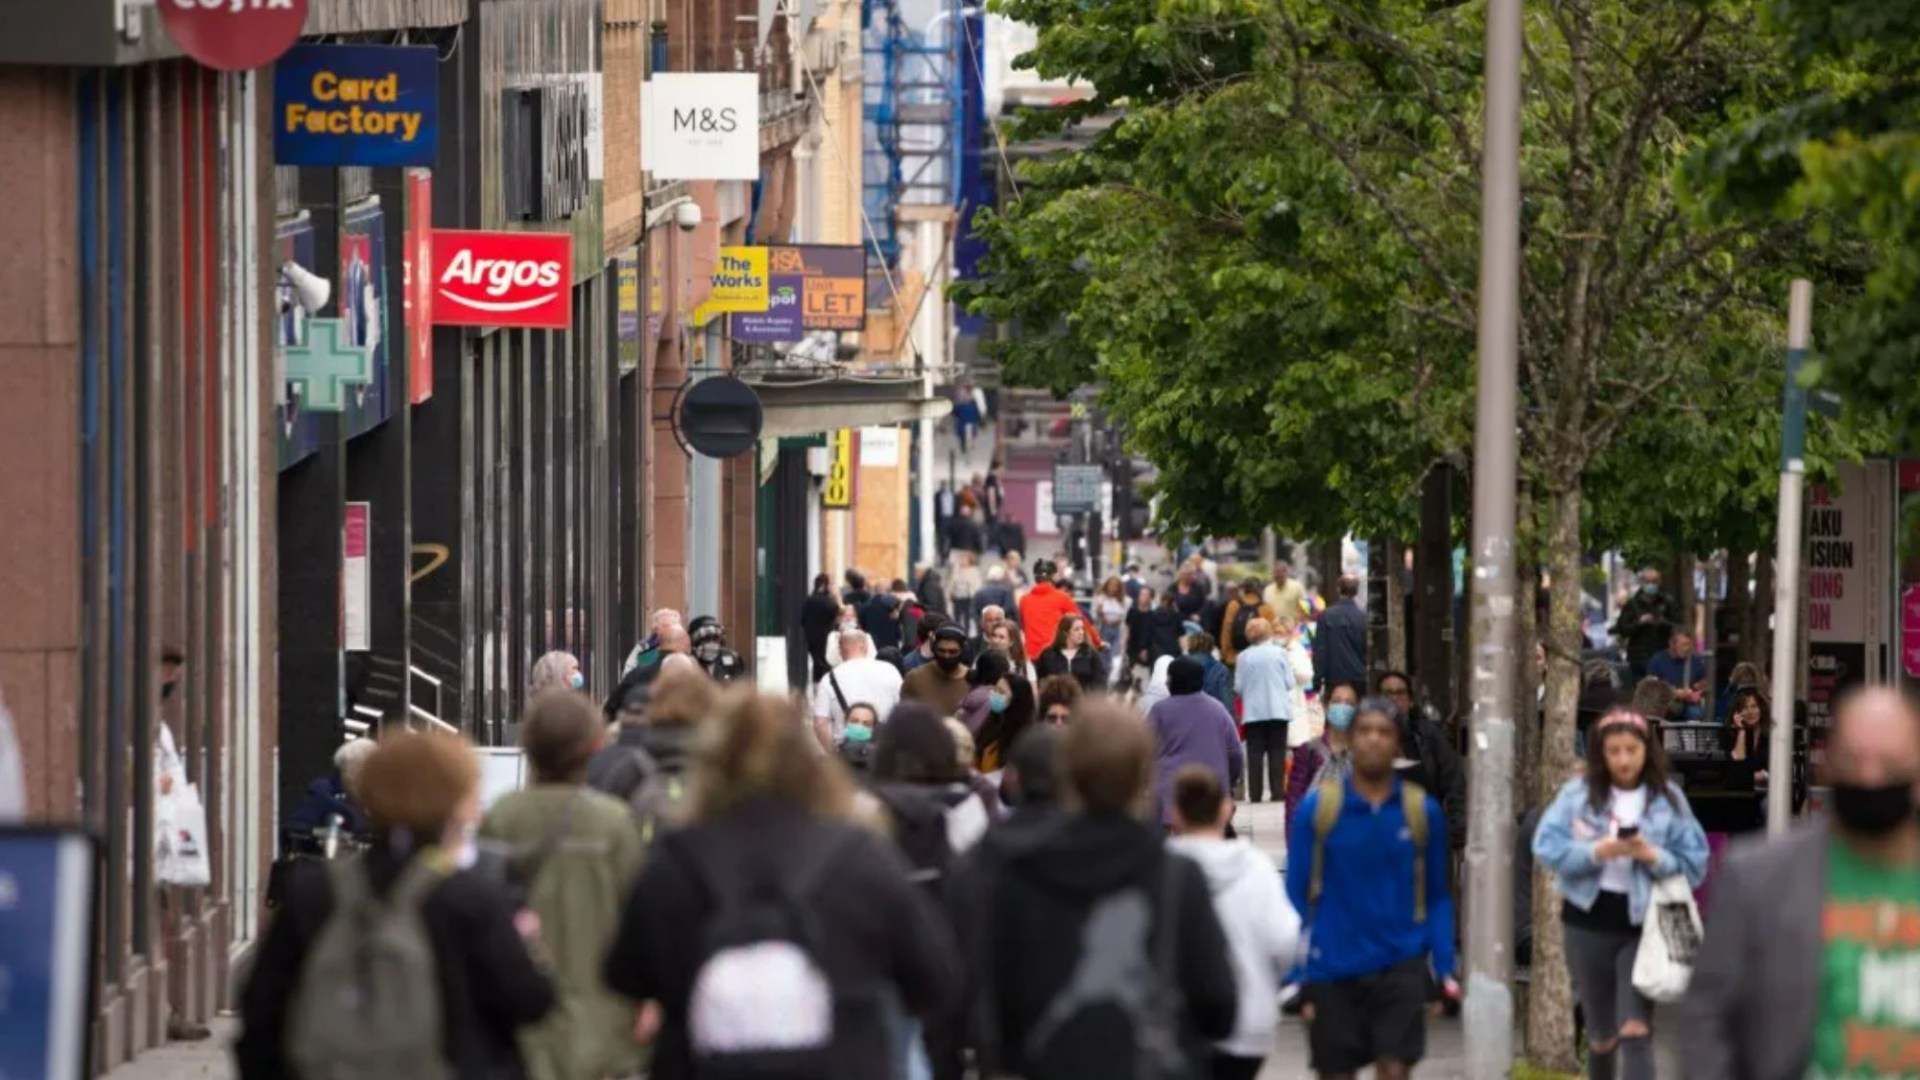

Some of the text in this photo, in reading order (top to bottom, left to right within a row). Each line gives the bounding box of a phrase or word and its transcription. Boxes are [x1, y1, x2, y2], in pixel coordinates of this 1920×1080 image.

[311, 70, 398, 102] Card
[285, 103, 422, 142] Factory
[673, 106, 738, 132] M&S
[440, 249, 562, 296] Argos
[721, 256, 752, 271] The
[711, 273, 762, 287] Works
[768, 293, 797, 309] pot
[807, 293, 857, 313] LET
